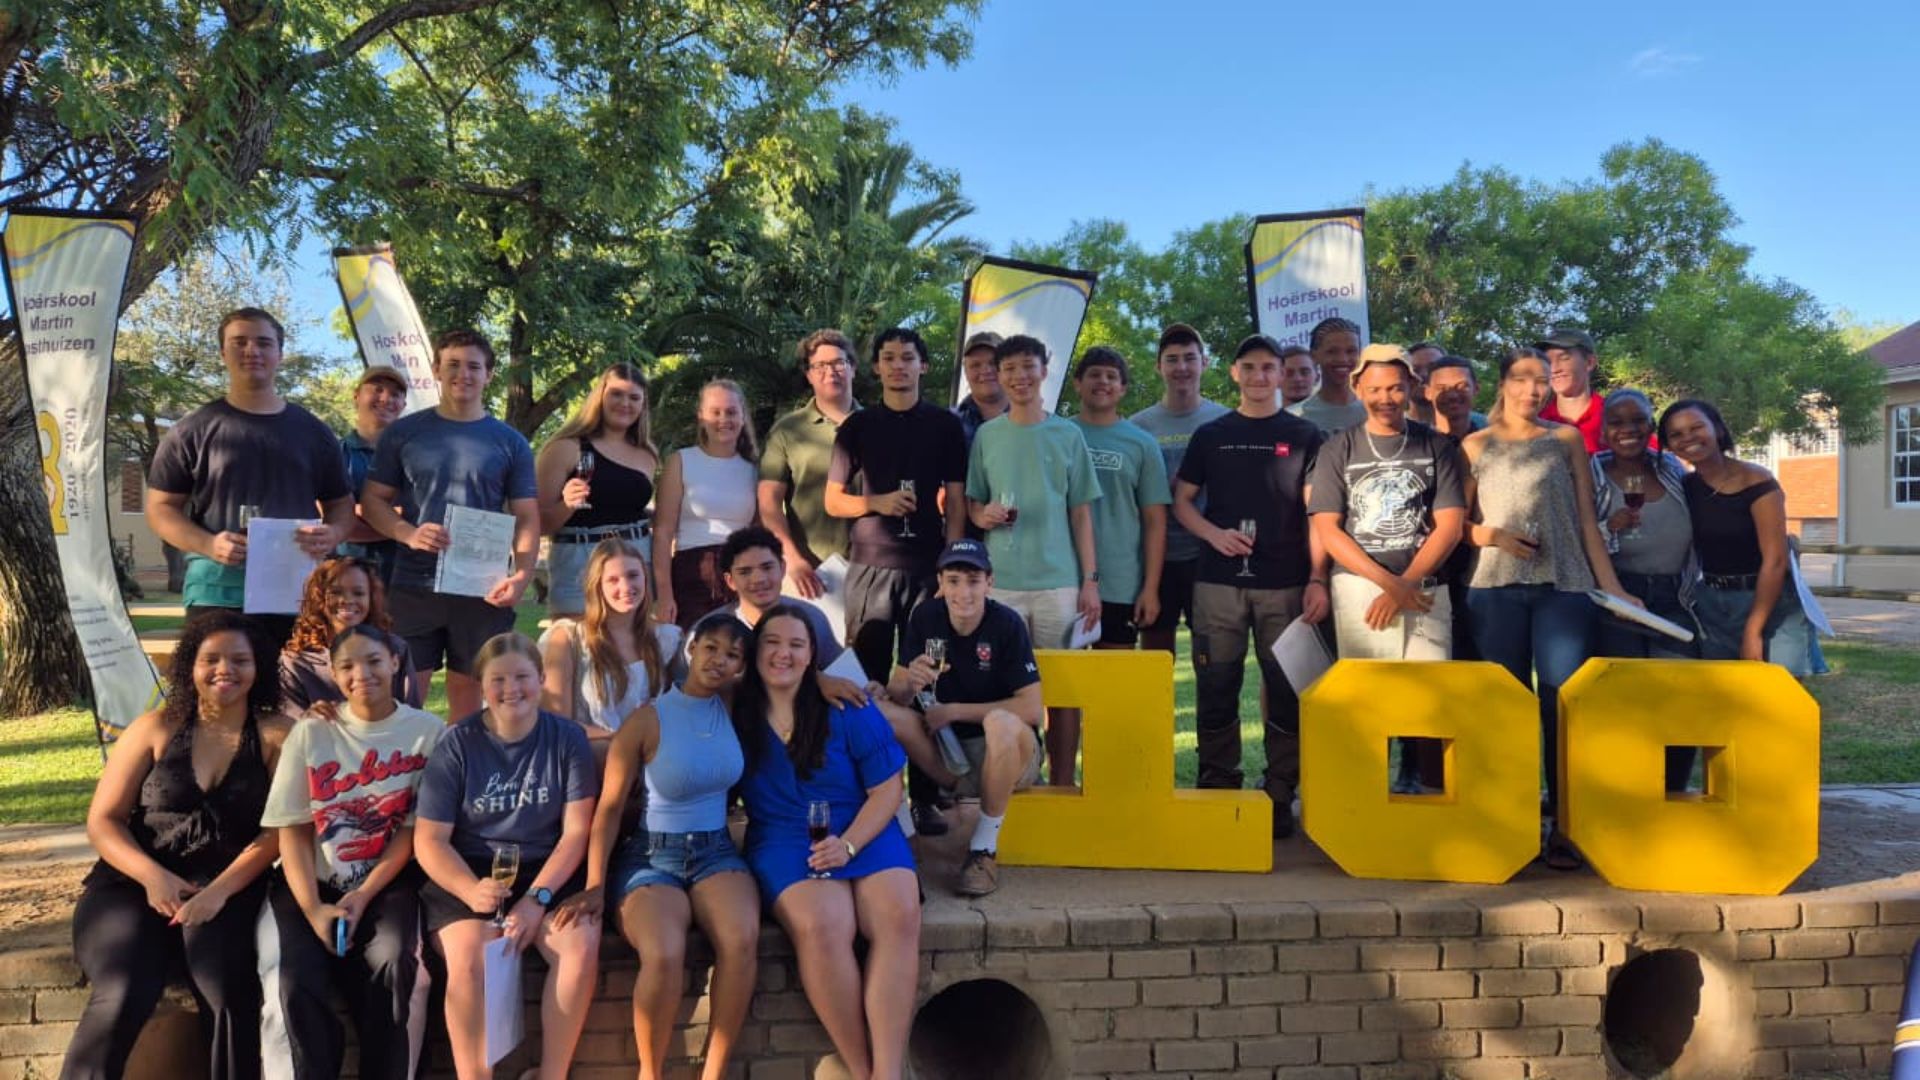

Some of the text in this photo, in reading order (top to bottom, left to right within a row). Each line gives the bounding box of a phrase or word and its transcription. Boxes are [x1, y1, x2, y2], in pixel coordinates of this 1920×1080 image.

[1268, 282, 1354, 312] Hoërskool
[1284, 304, 1339, 328] Martin
[67, 474, 80, 519] 1920
[473, 787, 550, 814] SHINE
